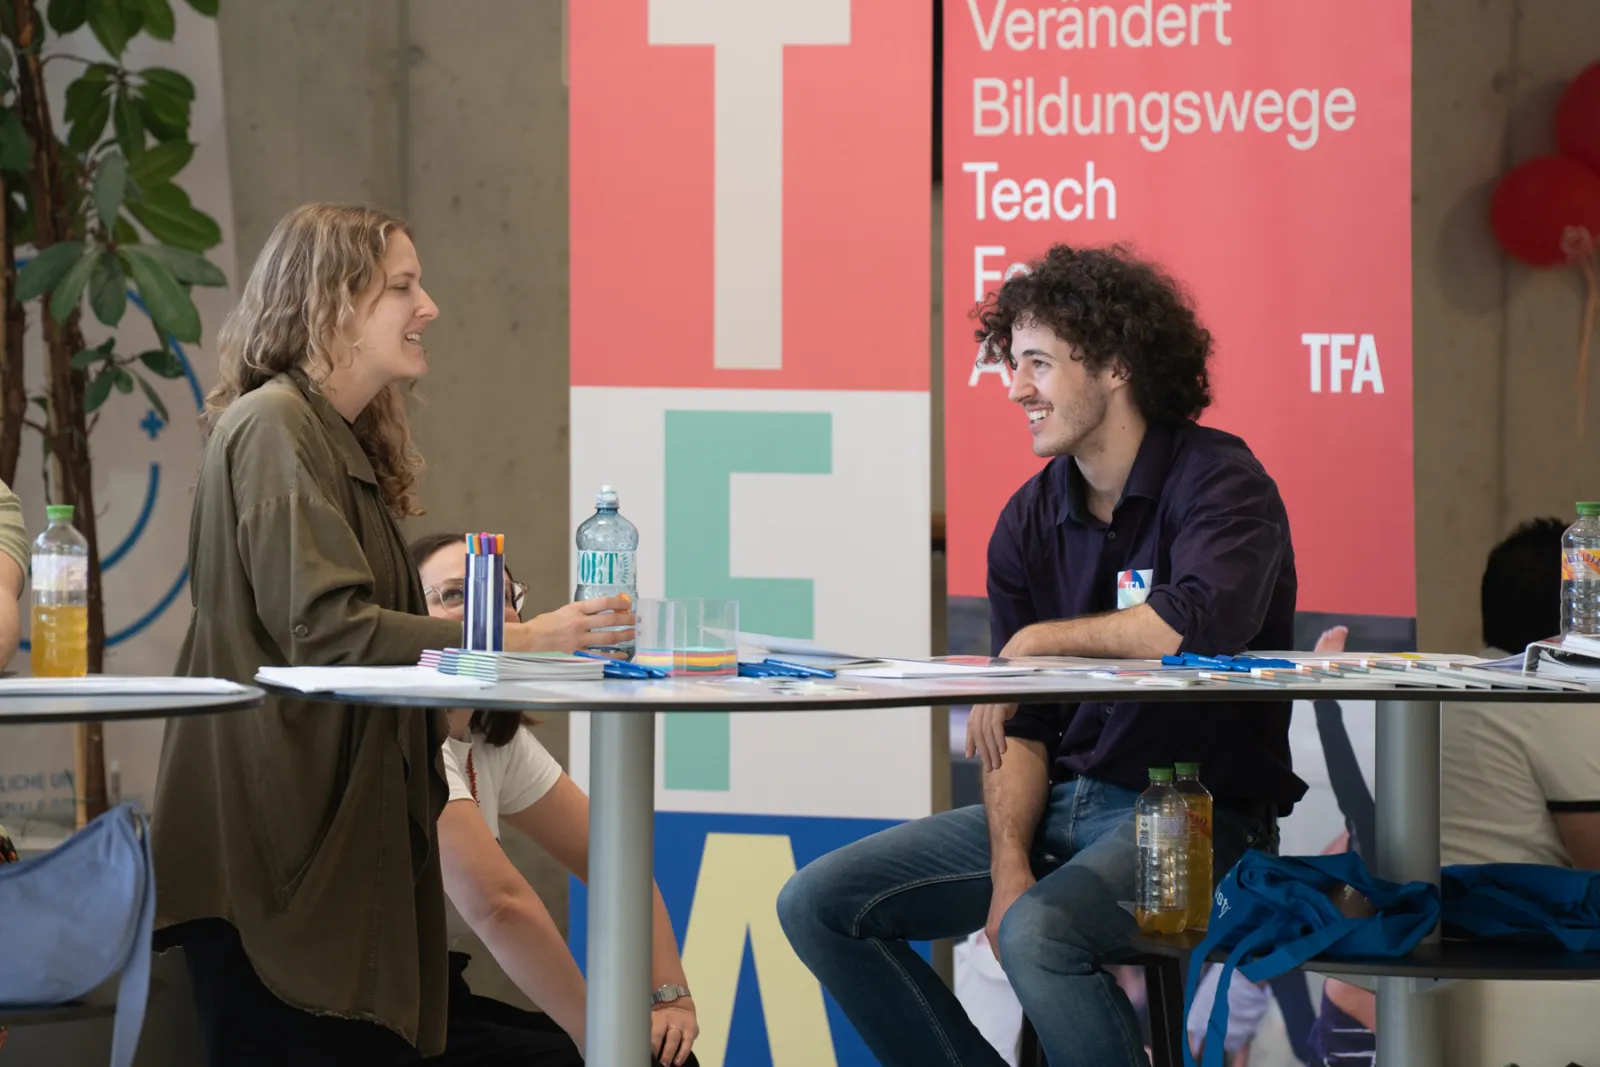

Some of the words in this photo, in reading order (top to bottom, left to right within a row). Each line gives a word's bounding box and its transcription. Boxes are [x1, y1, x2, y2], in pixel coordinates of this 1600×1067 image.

[966, 0, 1232, 51] Verändert
[973, 76, 1356, 152] Bildungswege
[963, 161, 1116, 221] Teach
[1302, 333, 1384, 394] TFA
